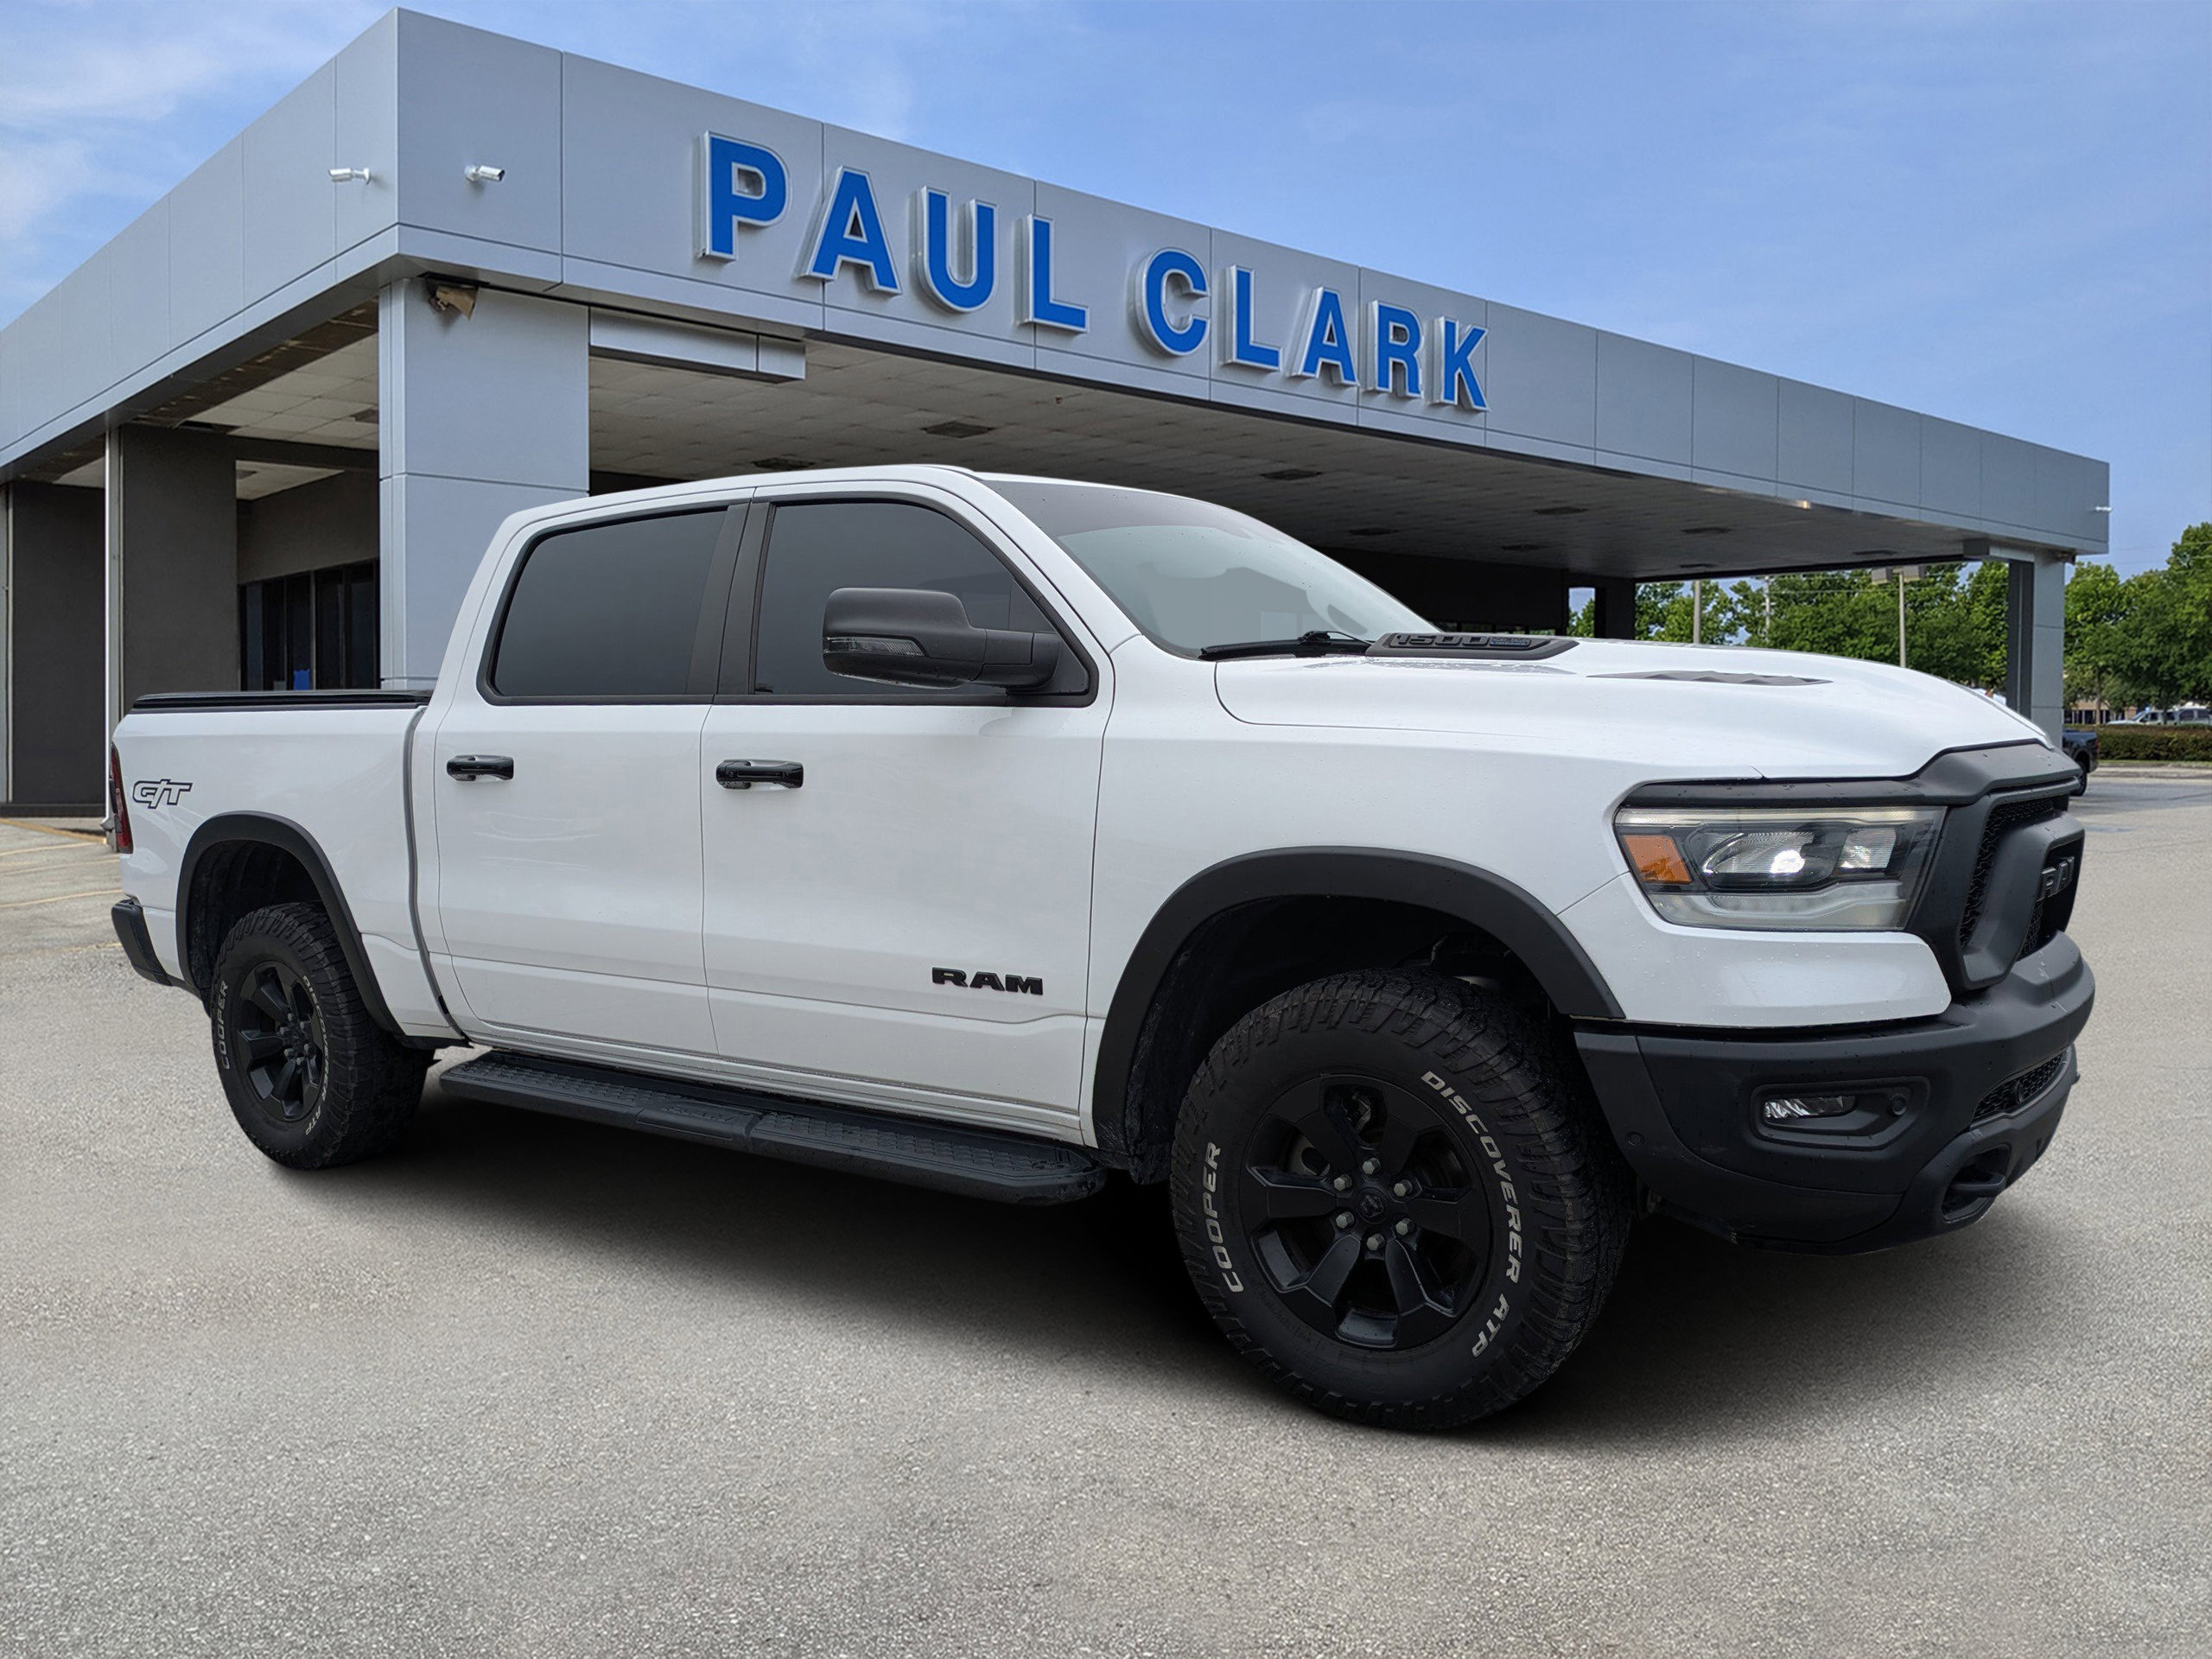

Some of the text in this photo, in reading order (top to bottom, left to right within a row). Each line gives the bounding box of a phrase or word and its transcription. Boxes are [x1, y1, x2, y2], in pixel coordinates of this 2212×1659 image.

[704, 132, 1489, 410] PAUL CLARK
[1397, 634, 1489, 646] 1500
[218, 980, 230, 1070] COOPER
[931, 967, 1043, 995] RAM
[1203, 1141, 1244, 1293] COOPER
[1421, 1071, 1522, 1359] DISCOVERER ATP
